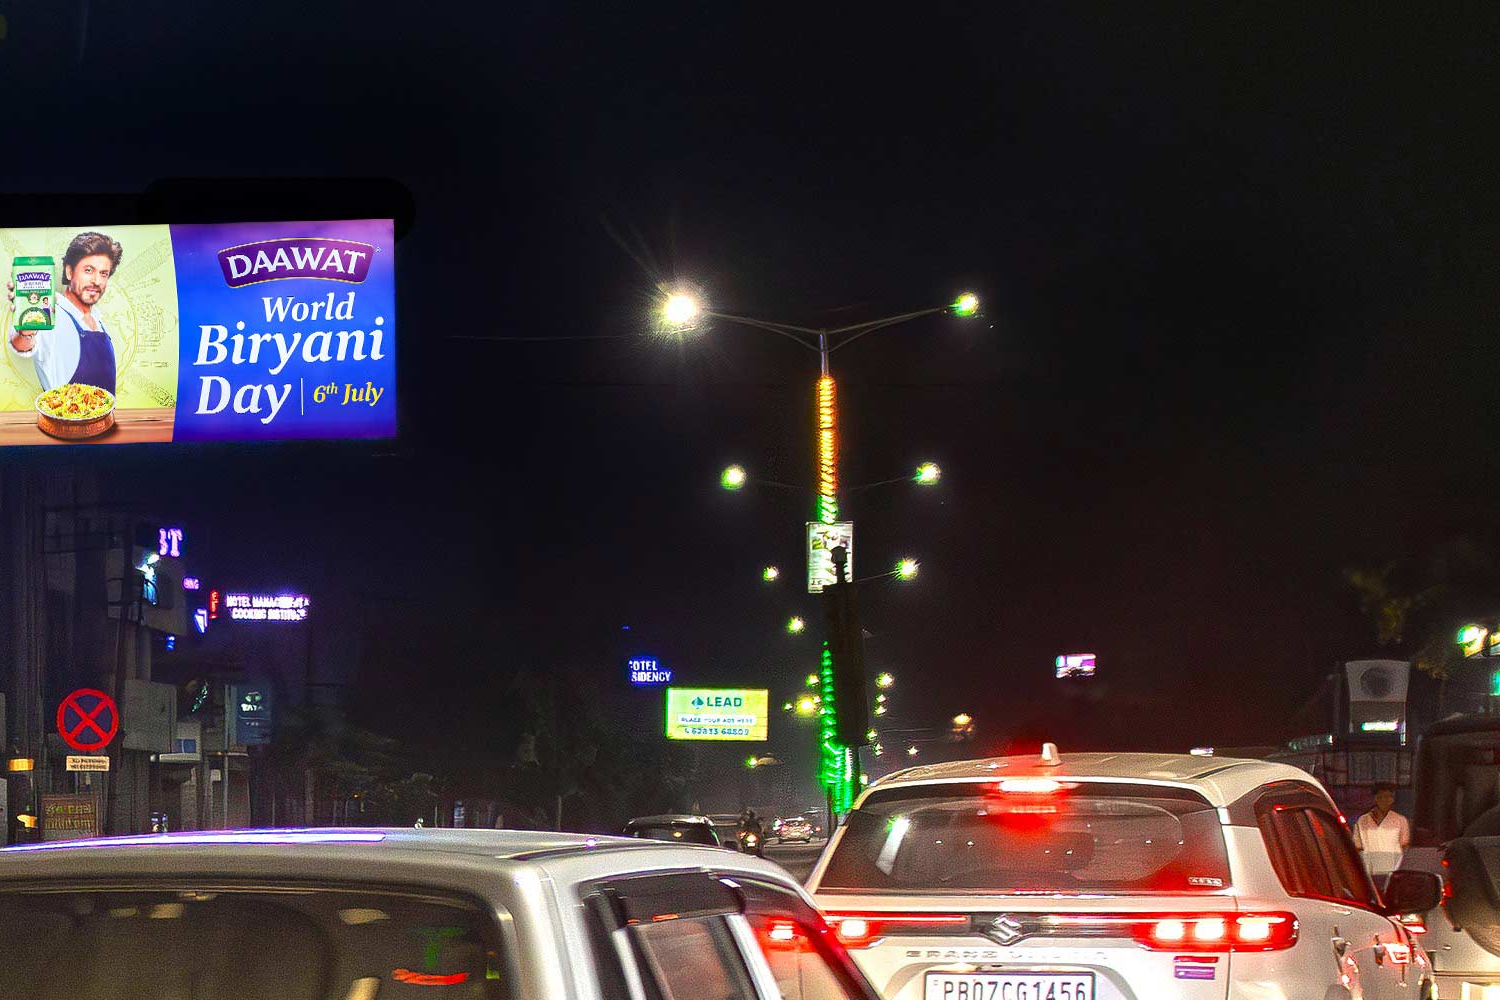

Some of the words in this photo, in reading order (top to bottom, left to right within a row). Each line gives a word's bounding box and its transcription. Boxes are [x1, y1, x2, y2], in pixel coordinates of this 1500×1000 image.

[227, 246, 366, 280] DAAWAT
[261, 292, 355, 323] World
[193, 317, 385, 376] Biryani
[195, 376, 292, 424] Day
[313, 382, 338, 404] 6th
[342, 382, 384, 407] July
[707, 696, 742, 707] LEAD
